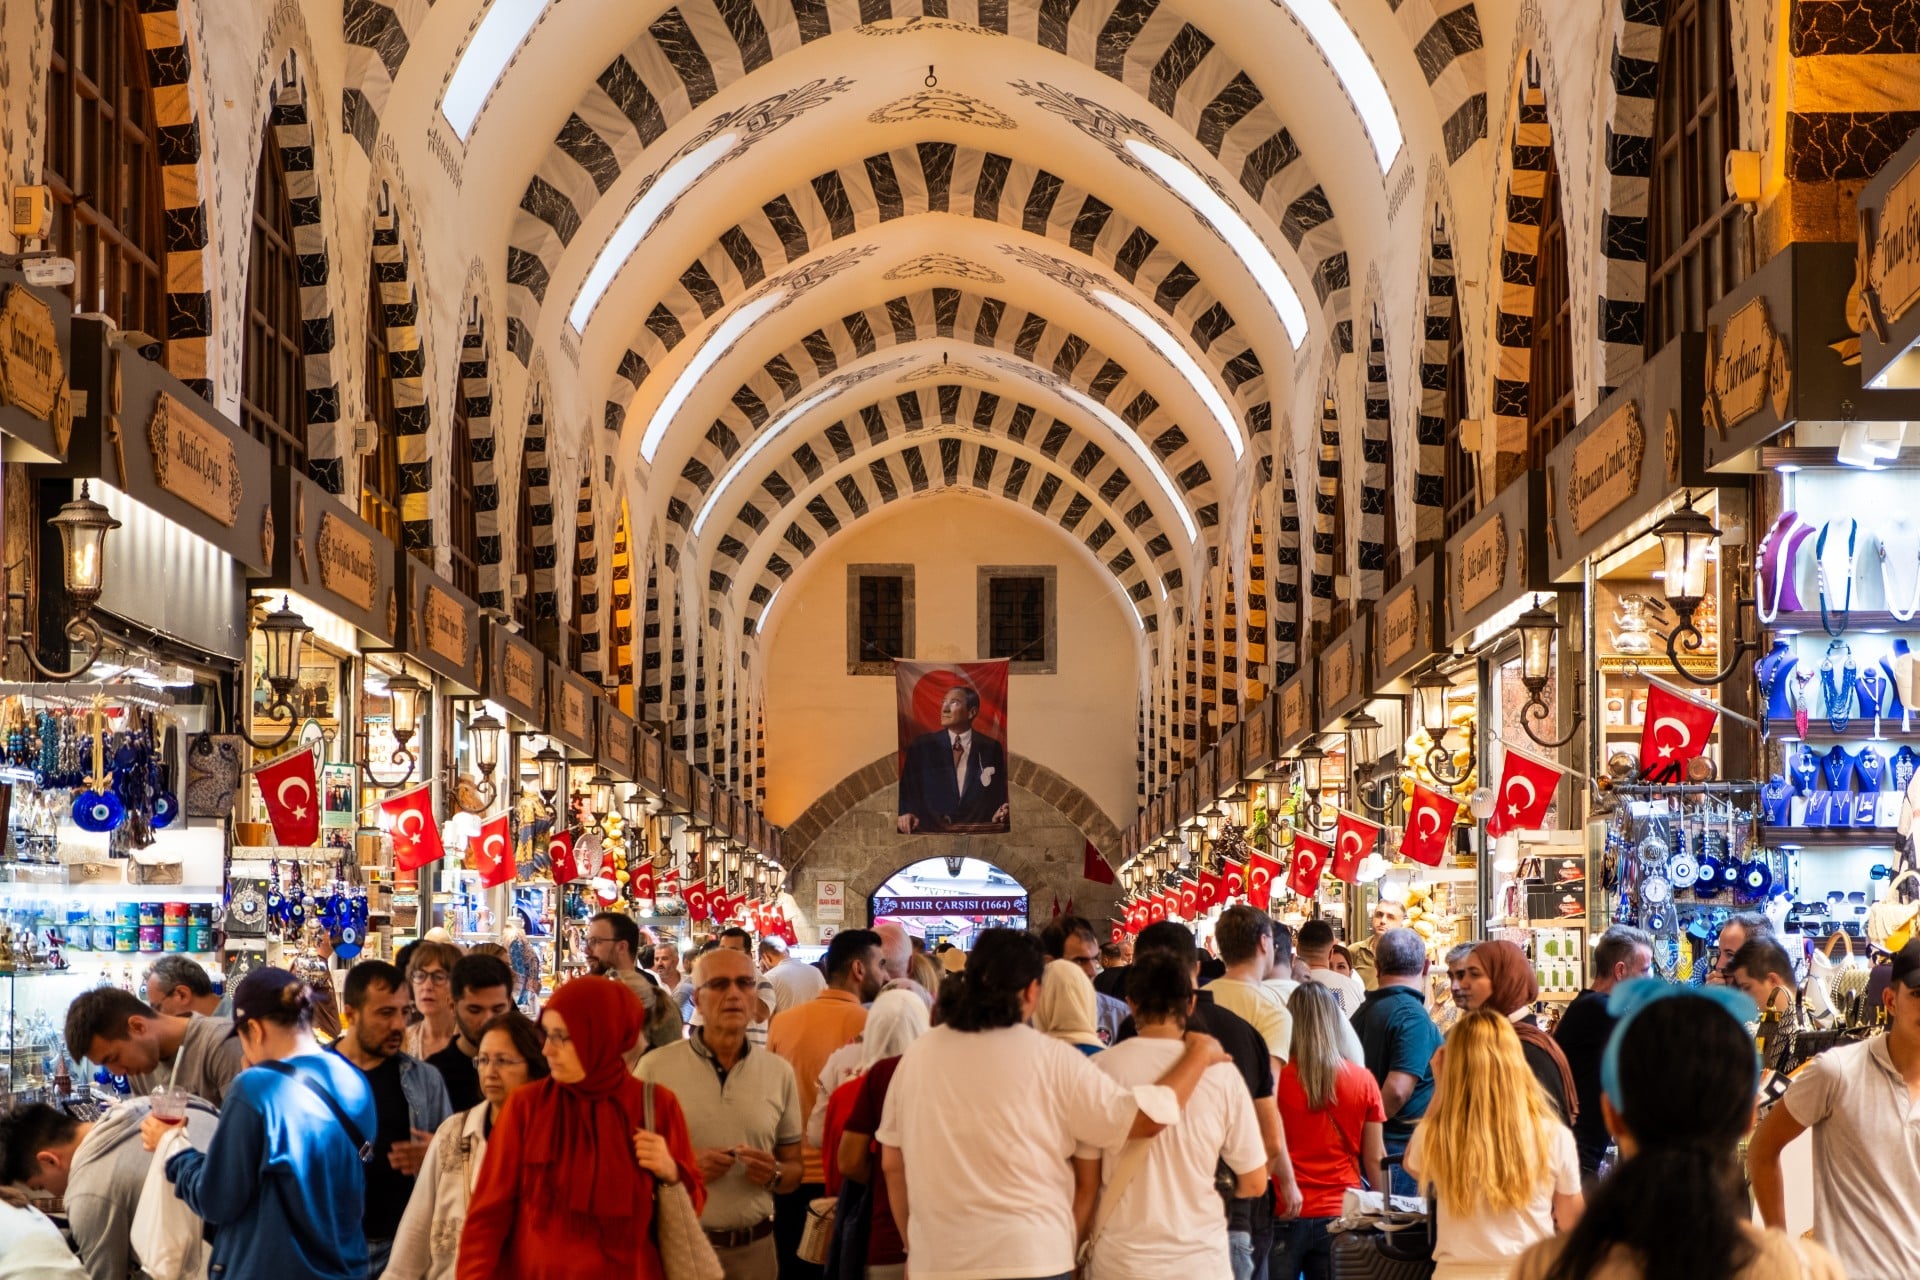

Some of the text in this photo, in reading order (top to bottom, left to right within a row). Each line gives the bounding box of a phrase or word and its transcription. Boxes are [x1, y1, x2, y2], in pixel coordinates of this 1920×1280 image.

[1882, 222, 1905, 277] Tuna
[1723, 340, 1761, 395] Turkuaz
[176, 430, 222, 494] Mutlu Çeyiz
[900, 900, 1011, 911] MISIR ÇARŞISI (1664)
